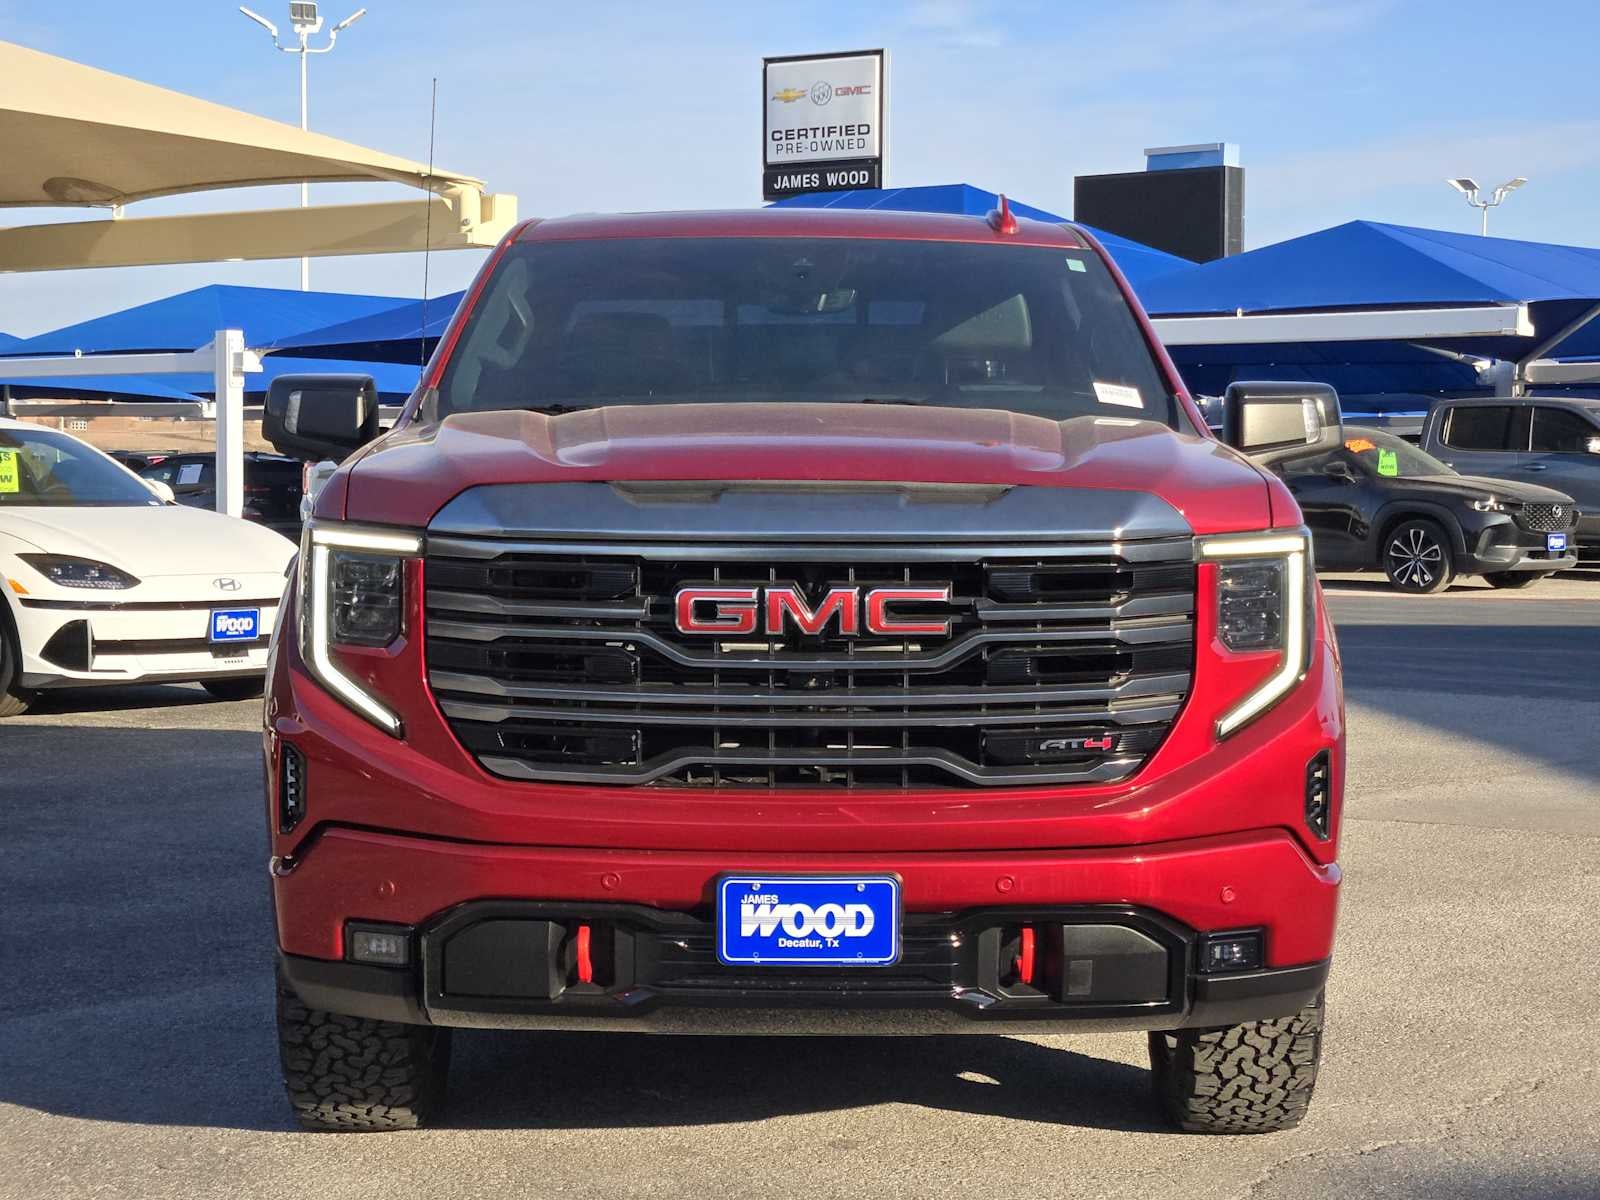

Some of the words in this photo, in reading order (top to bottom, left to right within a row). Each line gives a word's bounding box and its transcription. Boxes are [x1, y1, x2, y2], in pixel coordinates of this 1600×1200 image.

[835, 85, 872, 97] GMC
[771, 123, 870, 142] CERTIFIED
[776, 138, 866, 155] PRE-OWNED
[774, 173, 819, 189] JAMES
[826, 171, 869, 186] WOOD
[674, 587, 952, 636] GMC
[216, 617, 254, 633] WOOD
[1040, 736, 1112, 751] AT4
[741, 894, 779, 904] JAMES
[740, 903, 875, 938] WOOD
[778, 938, 823, 949] Decatur,
[826, 938, 839, 948] Tx
